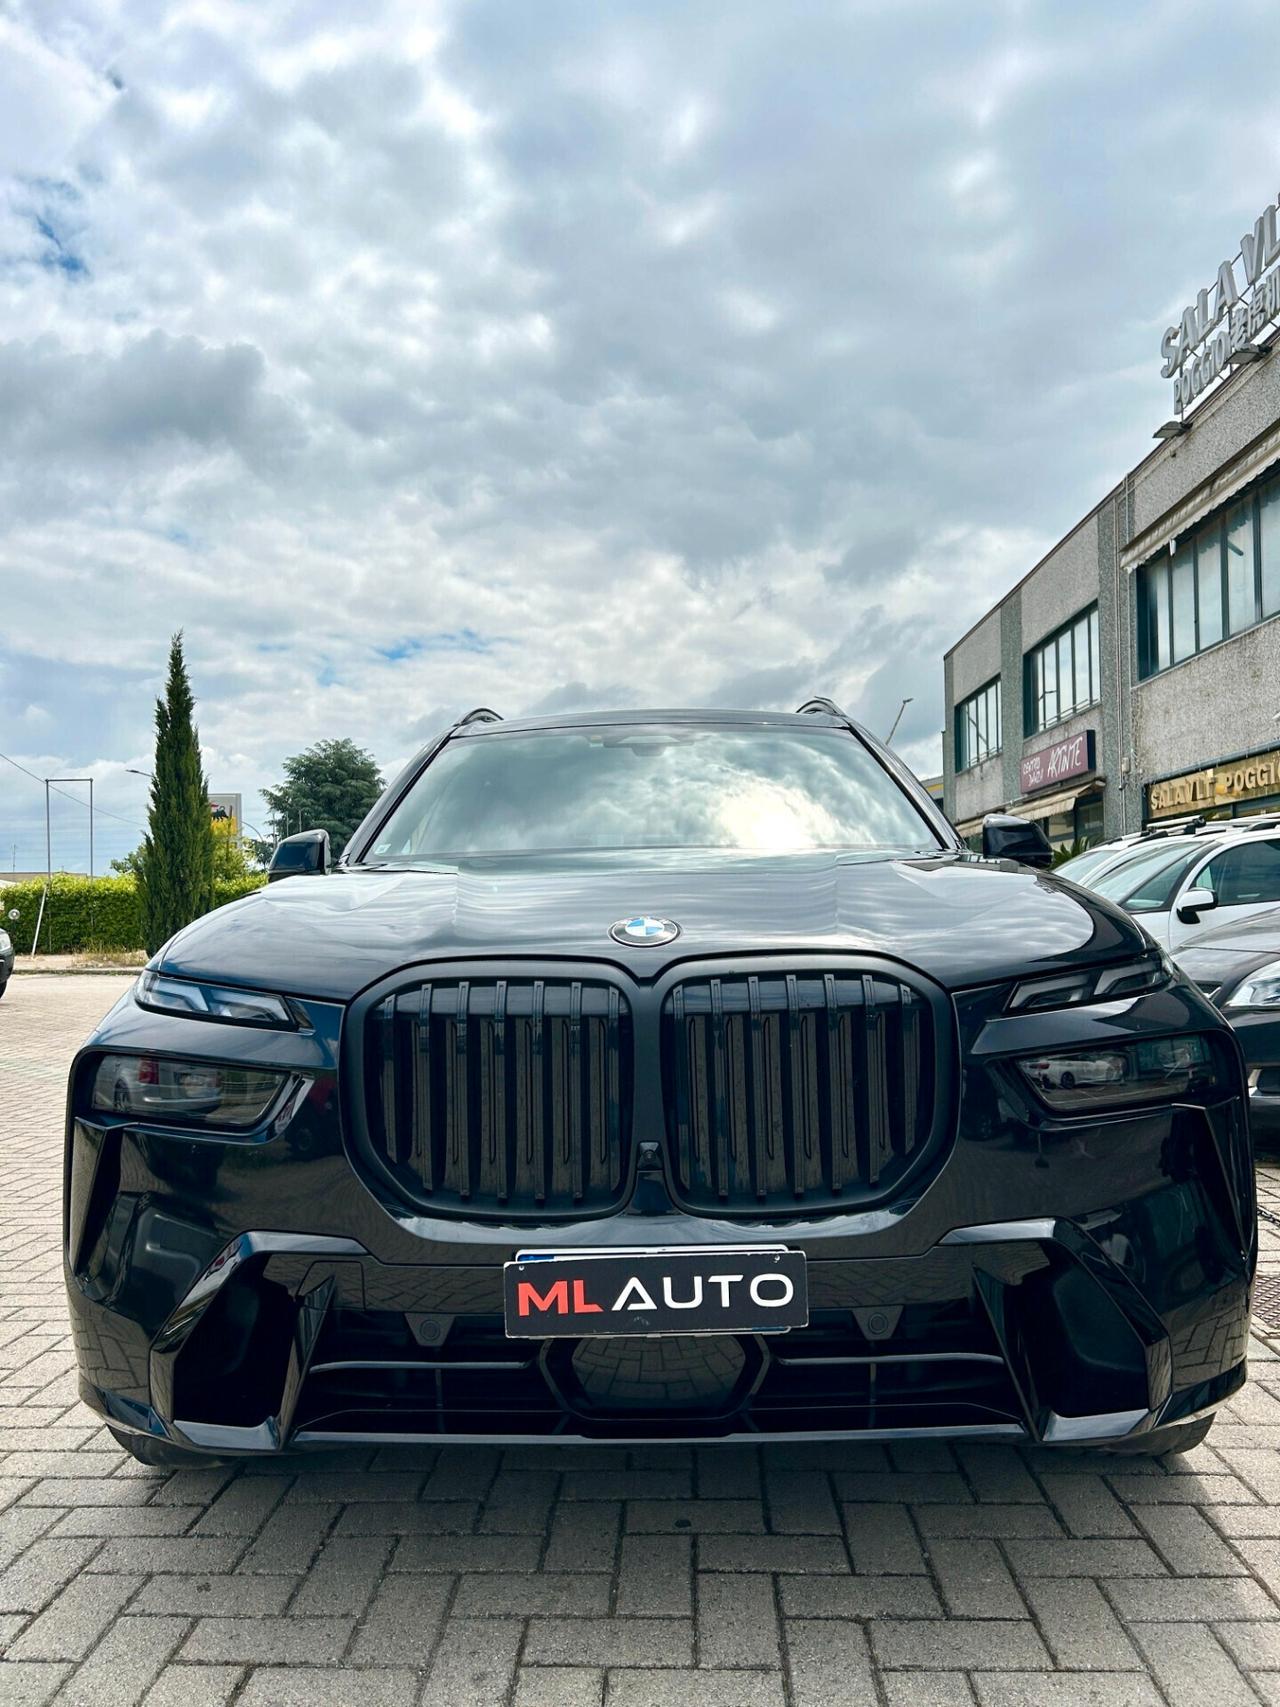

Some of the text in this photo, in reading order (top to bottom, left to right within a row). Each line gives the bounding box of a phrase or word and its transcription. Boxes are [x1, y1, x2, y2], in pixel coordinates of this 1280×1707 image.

[1161, 192, 1280, 378] SALA VL
[1174, 331, 1231, 415] POGGIO
[1225, 760, 1280, 793] POGGI
[518, 1273, 794, 1316] ML AUTO
